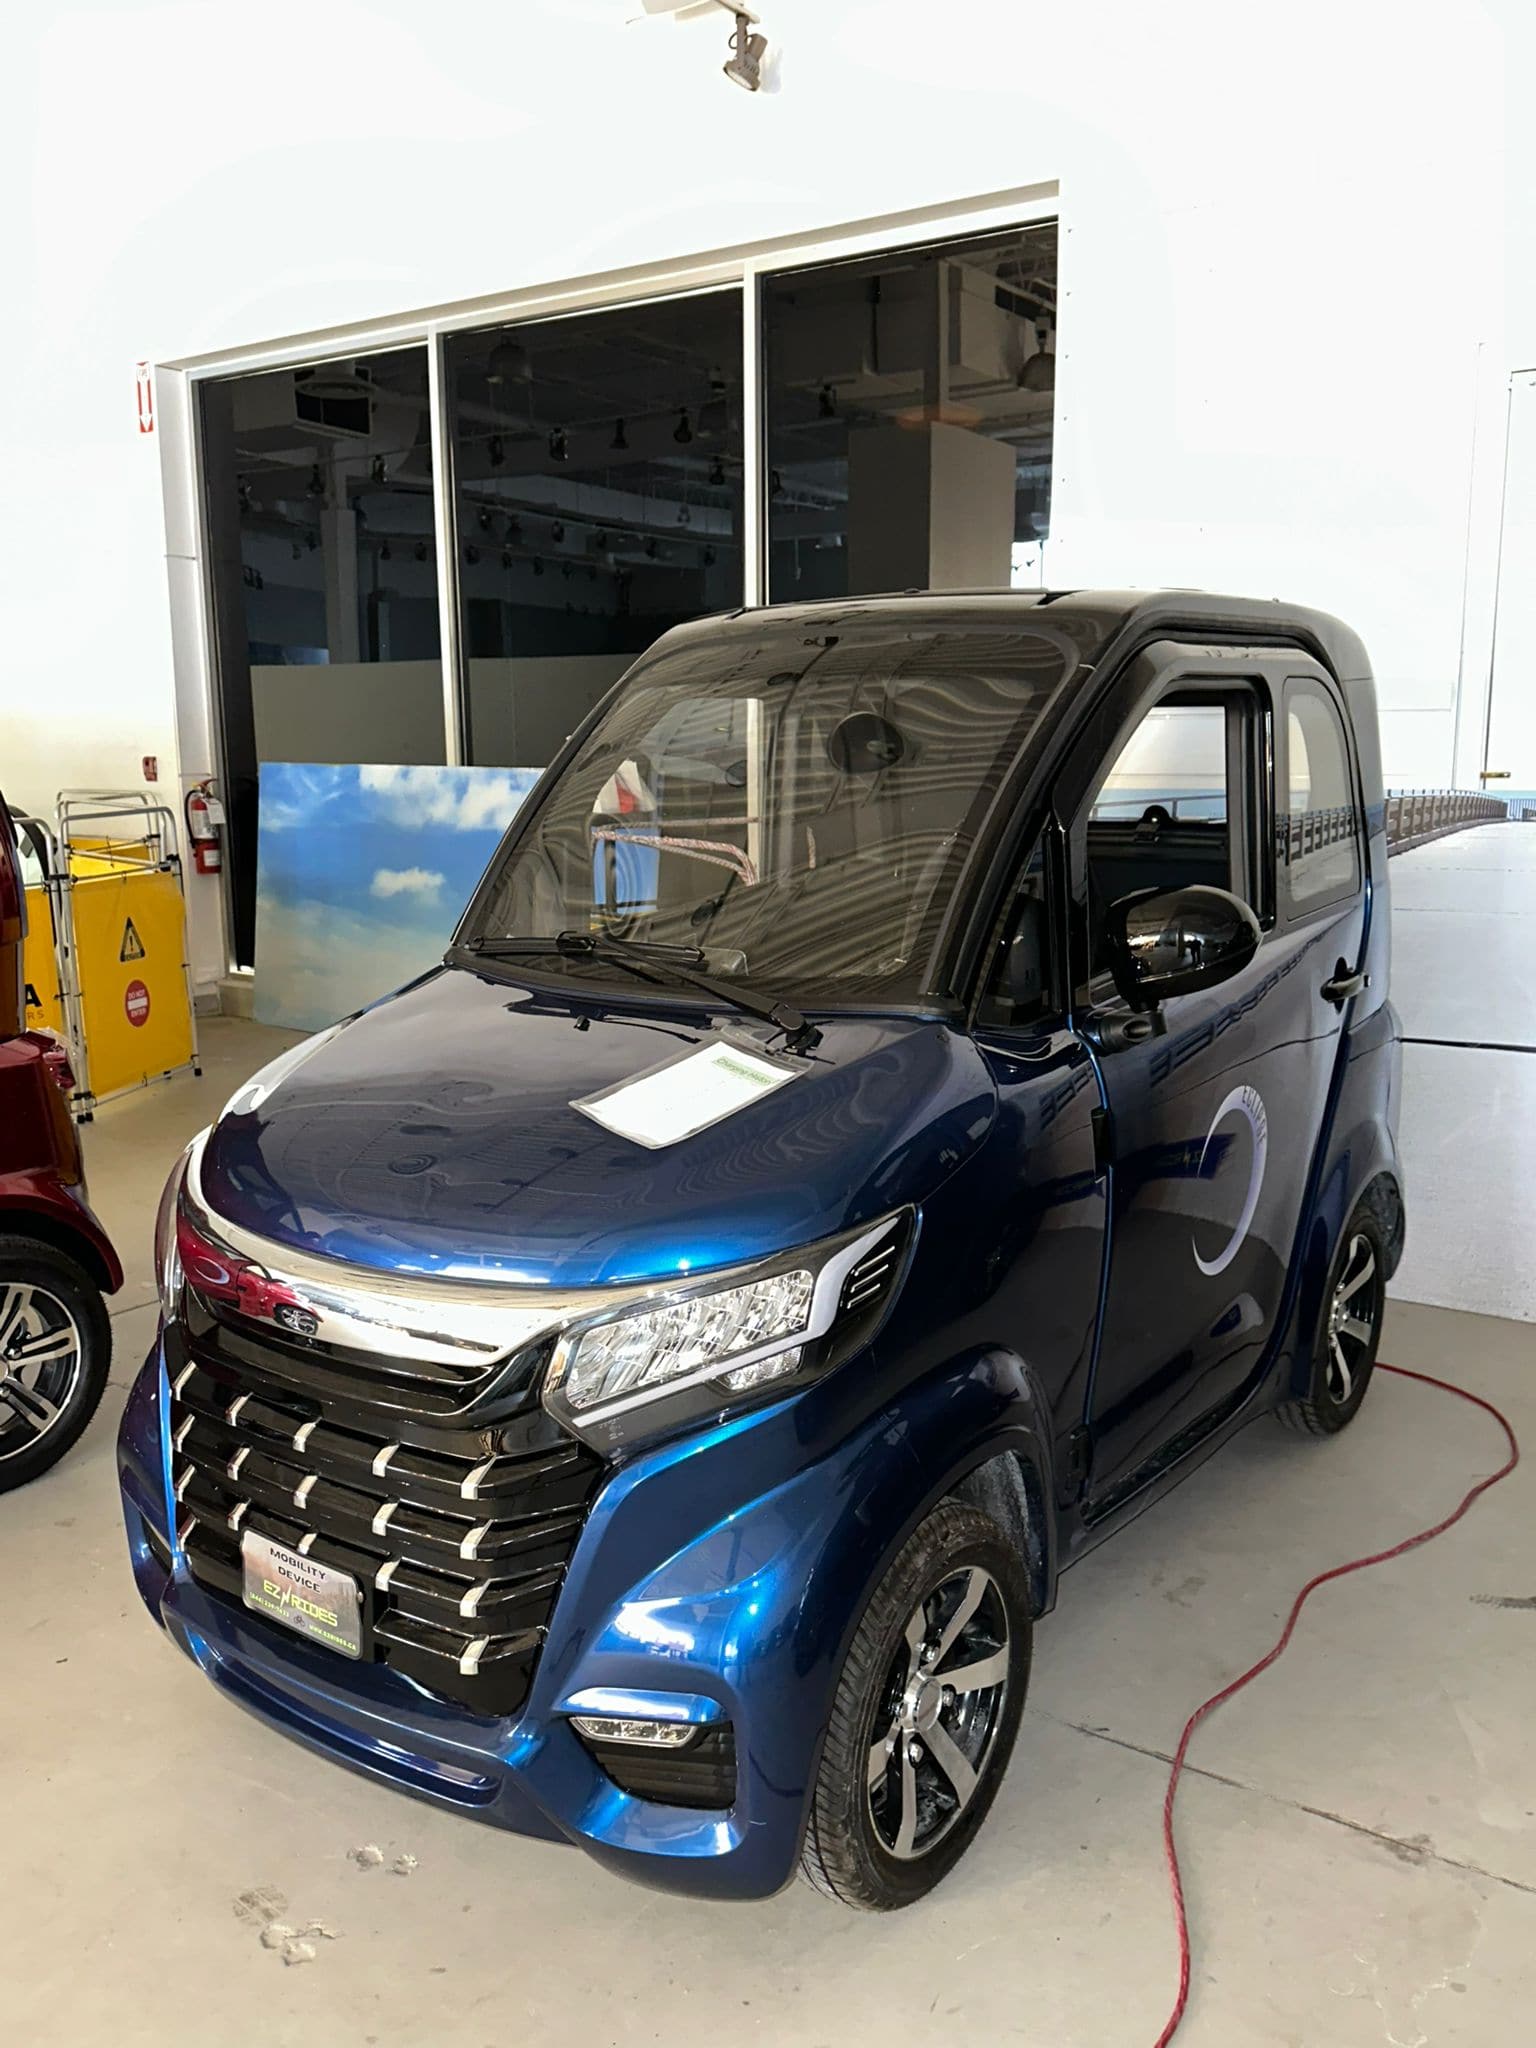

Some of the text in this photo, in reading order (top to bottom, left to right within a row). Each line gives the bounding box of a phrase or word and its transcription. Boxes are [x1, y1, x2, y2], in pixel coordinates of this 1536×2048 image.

[128, 989, 146, 1000] DO NOT
[131, 1007, 147, 1018] ENTER
[270, 1547, 327, 1580] MOBILITY
[278, 1566, 321, 1593] DEVICE
[291, 1593, 338, 1627] RIDES
